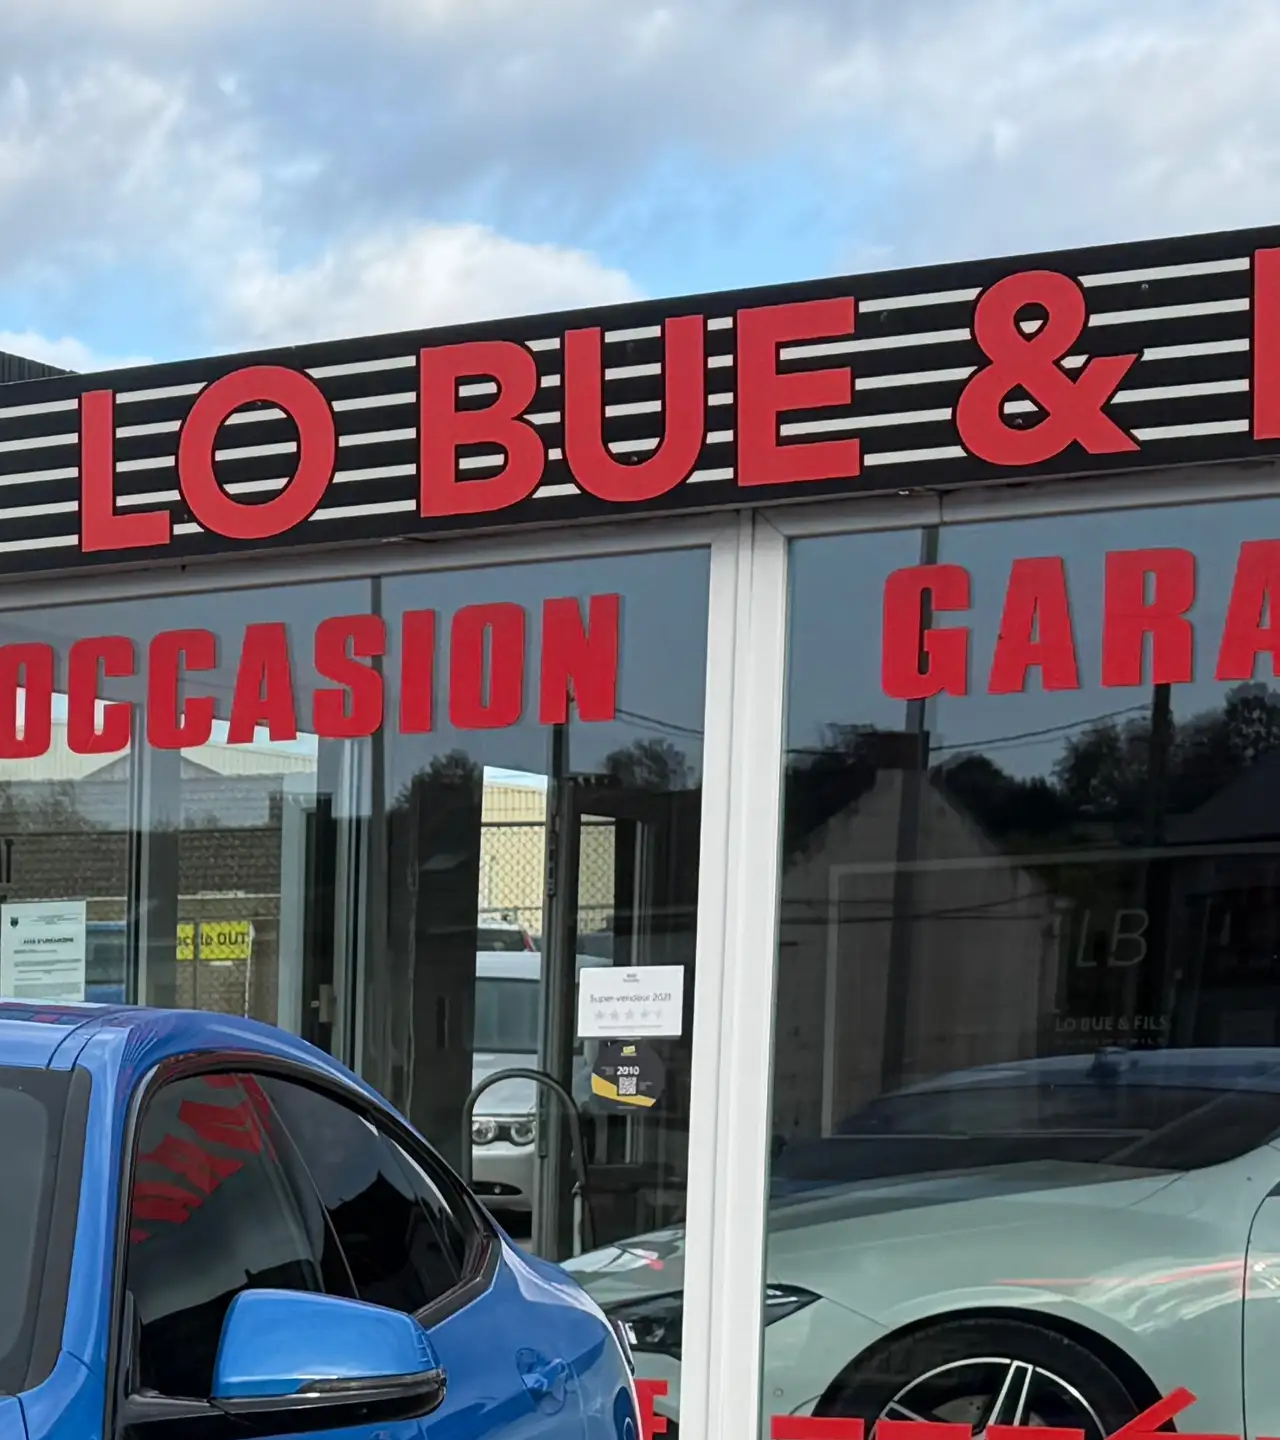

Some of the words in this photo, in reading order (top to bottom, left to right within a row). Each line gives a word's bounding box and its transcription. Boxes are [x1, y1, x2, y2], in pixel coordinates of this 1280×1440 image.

[81, 367, 336, 552] LO
[421, 297, 860, 518] BUE
[956, 270, 1140, 465] &
[882, 540, 1280, 700] GARA
